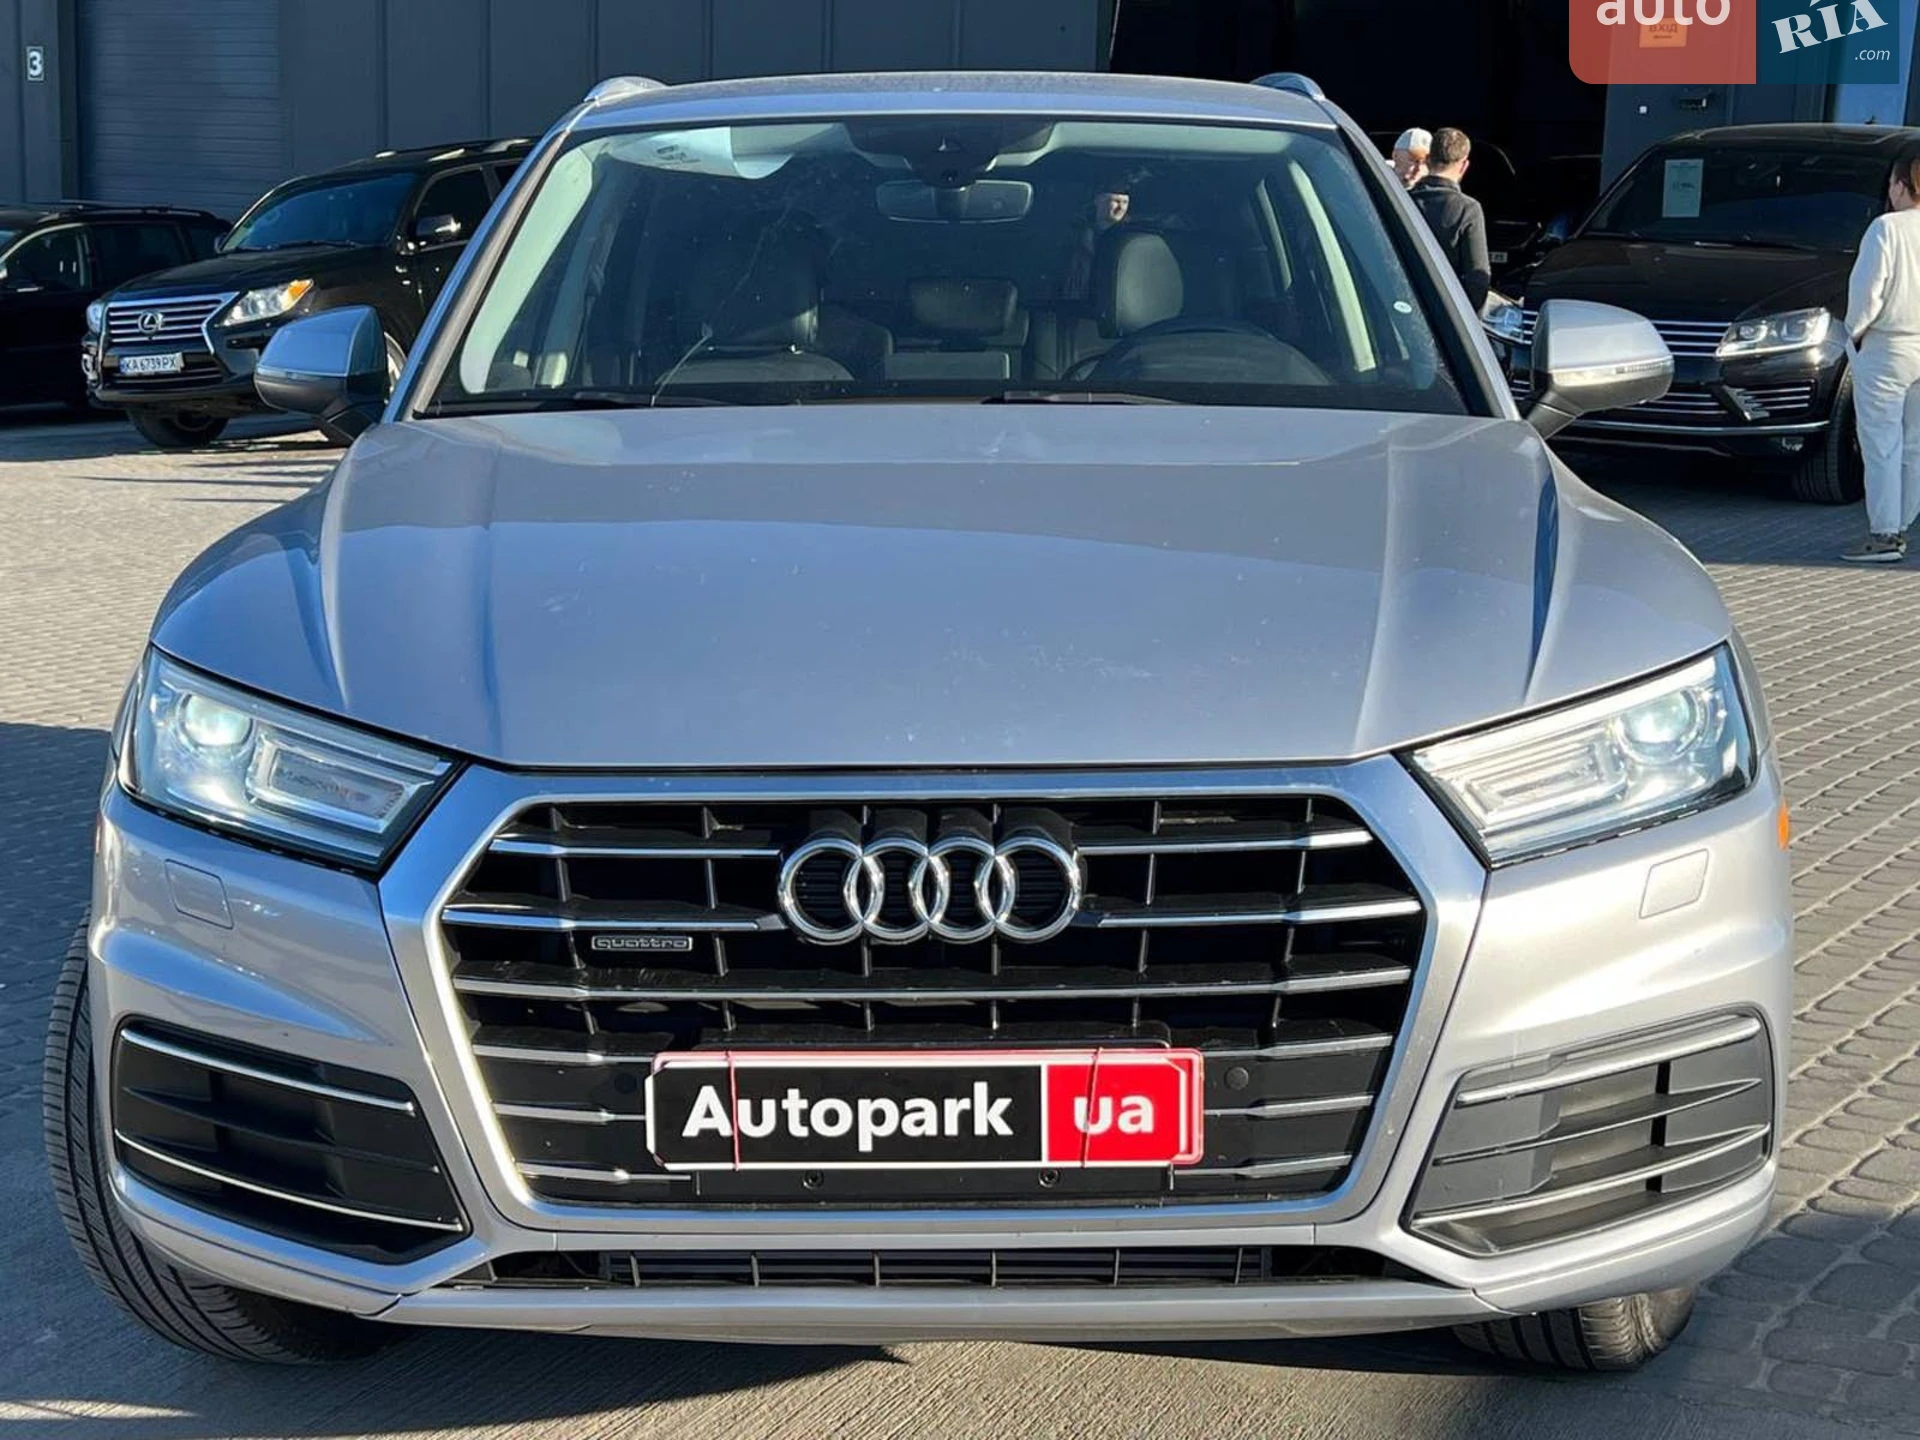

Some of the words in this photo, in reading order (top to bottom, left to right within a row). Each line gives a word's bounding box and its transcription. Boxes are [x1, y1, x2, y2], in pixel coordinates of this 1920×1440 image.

[29, 51, 43, 77] 3
[596, 938, 688, 950] quattro
[681, 1081, 1014, 1152] Autopark
[1072, 1093, 1155, 1135] ua
